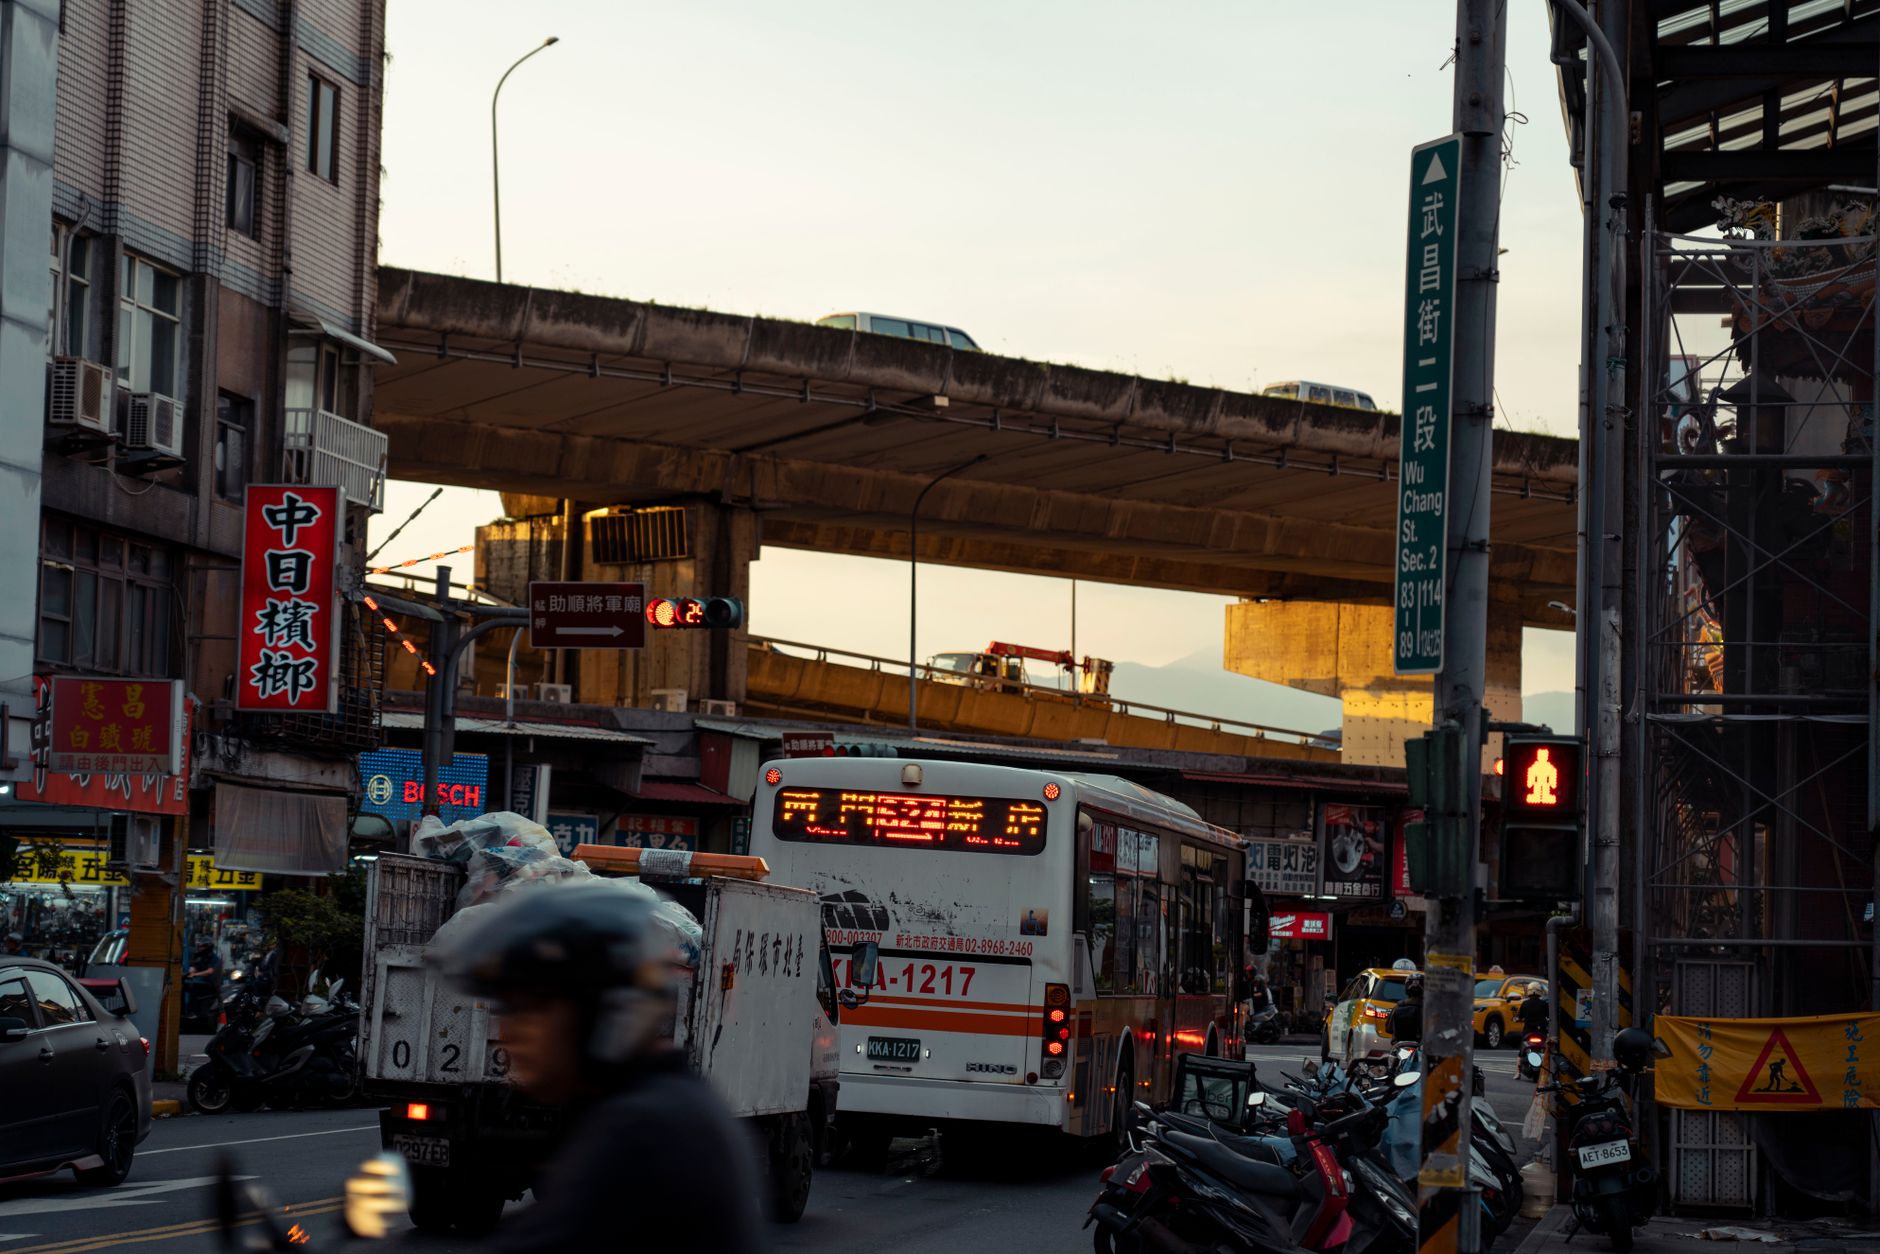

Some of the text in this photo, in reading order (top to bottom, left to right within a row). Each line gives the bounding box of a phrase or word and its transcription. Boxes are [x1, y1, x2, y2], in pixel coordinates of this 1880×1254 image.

[1413, 191, 1445, 454] 武昌街二段
[1405, 460, 1425, 486] Wu
[1403, 489, 1443, 518] Chang
[1402, 518, 1418, 544] St.
[1401, 544, 1438, 574] Sec. 2
[250, 491, 321, 706] 中日檳榔
[1400, 577, 1442, 609] 83 114
[1399, 630, 1414, 658] 89
[1204, 1088, 1232, 1103] ber
